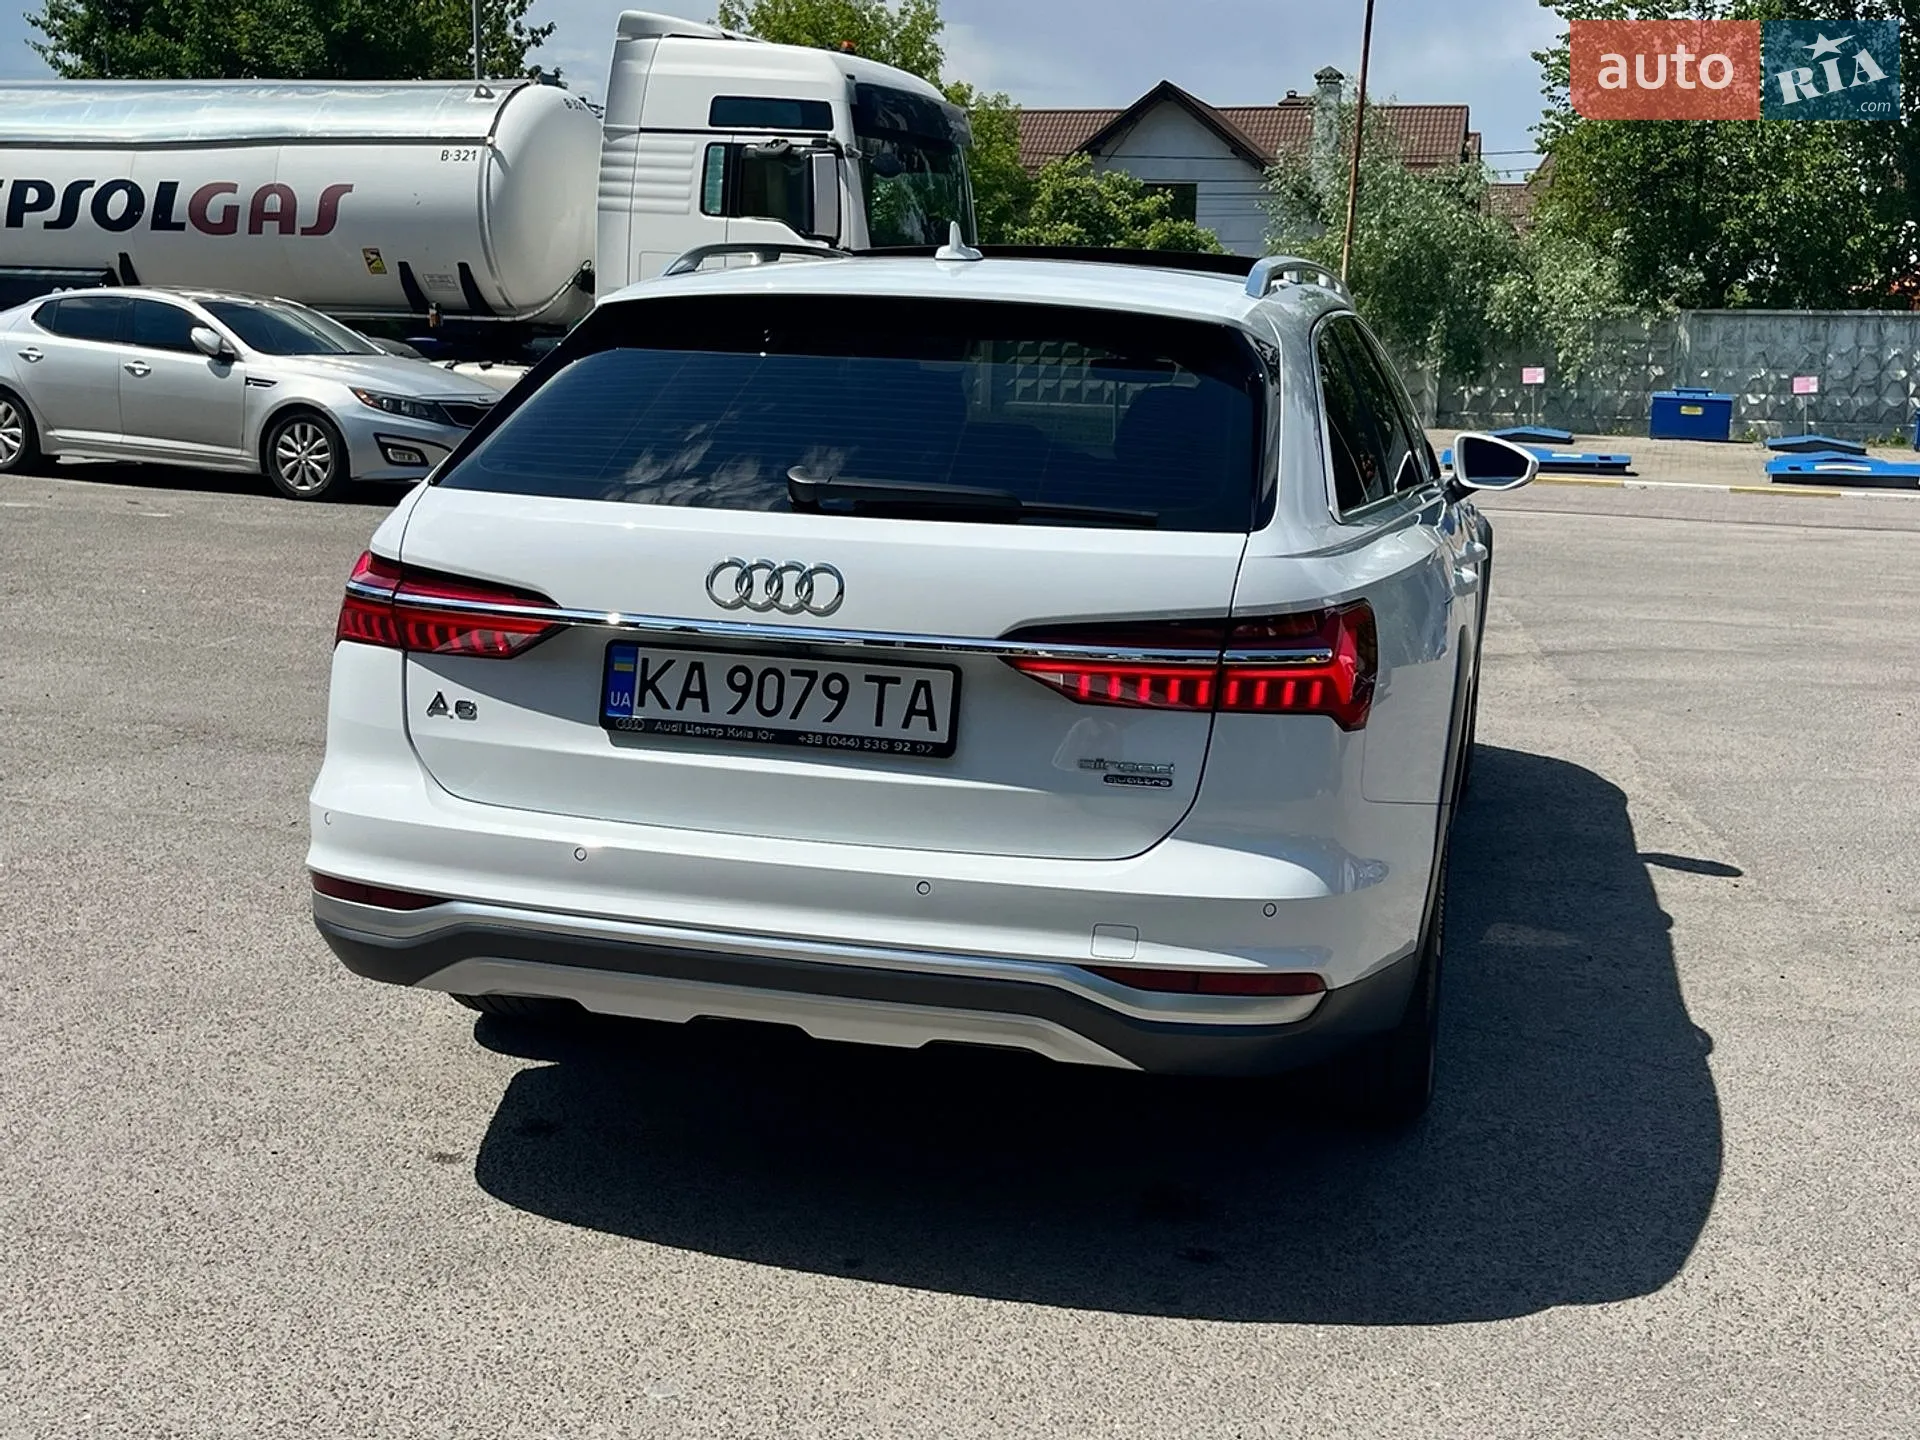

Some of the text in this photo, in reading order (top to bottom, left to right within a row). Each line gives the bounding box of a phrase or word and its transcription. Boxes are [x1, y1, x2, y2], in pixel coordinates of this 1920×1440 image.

[0, 178, 353, 236] PSOLGAS
[610, 691, 631, 708] UA
[637, 657, 938, 732] KA 9079 TA
[654, 720, 682, 733] Audi
[894, 742, 911, 753] 92
